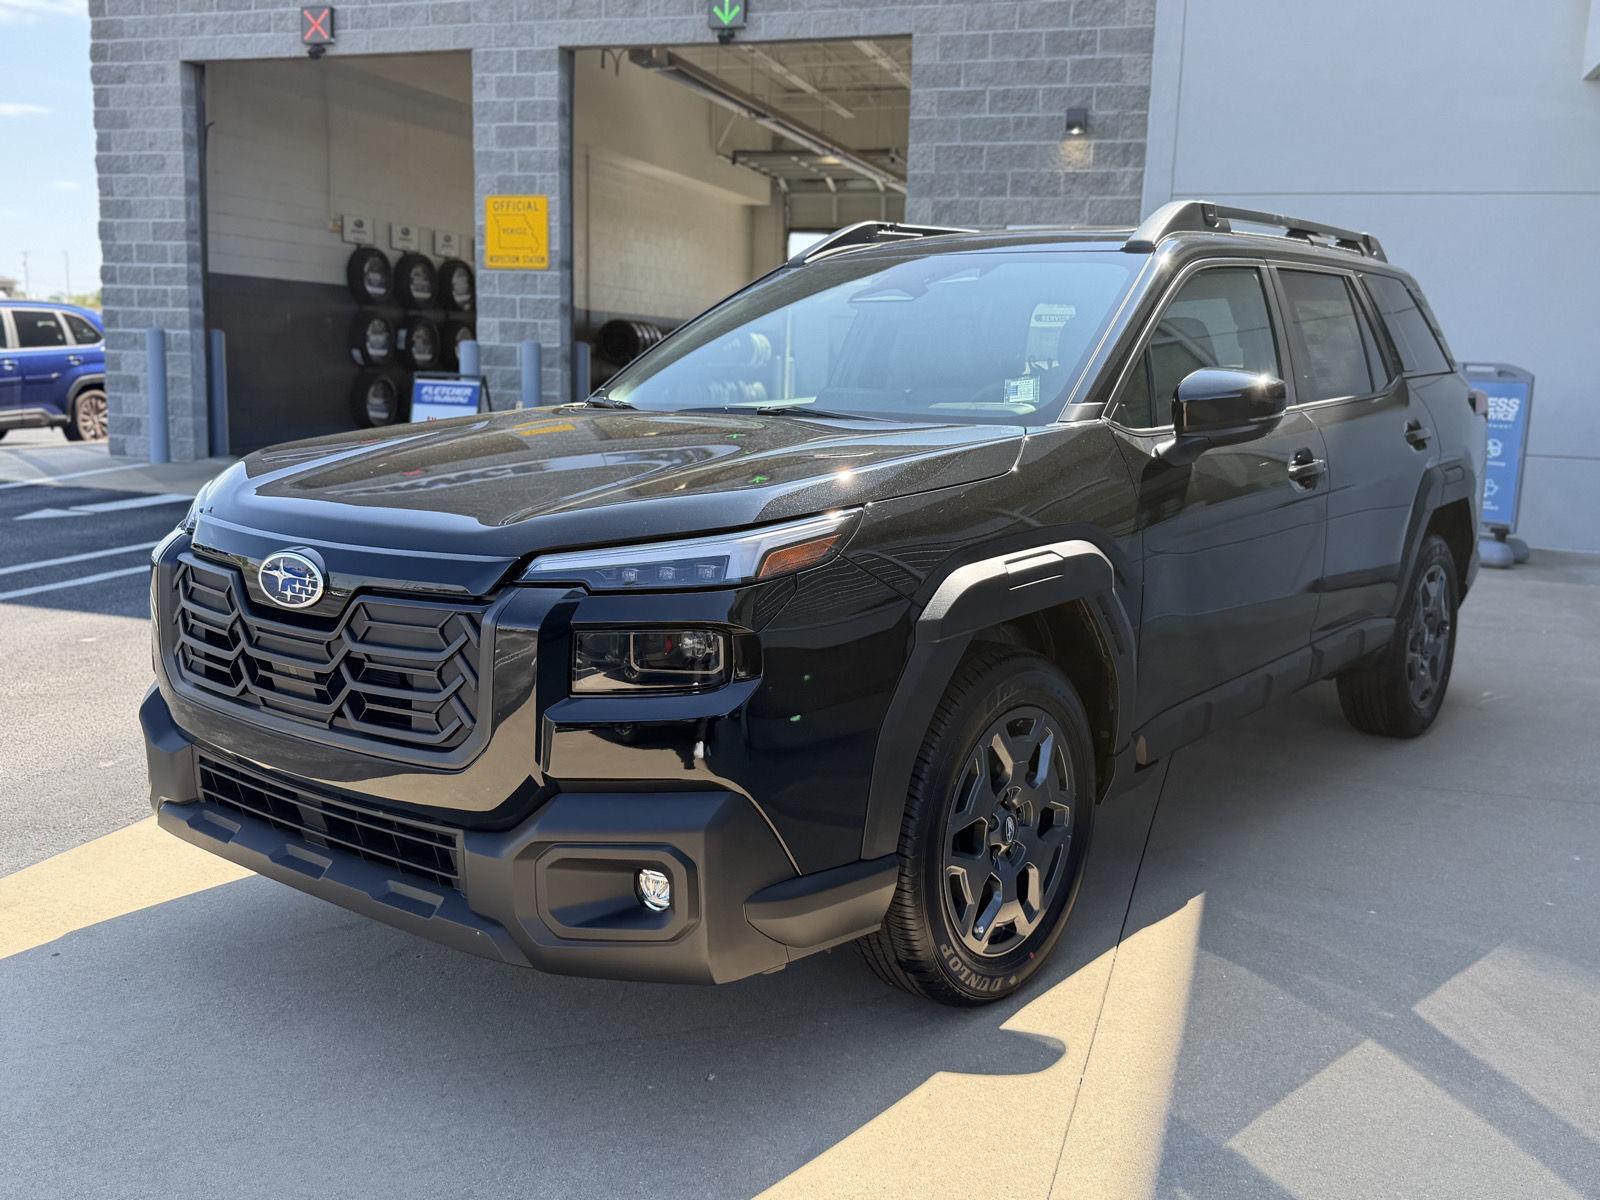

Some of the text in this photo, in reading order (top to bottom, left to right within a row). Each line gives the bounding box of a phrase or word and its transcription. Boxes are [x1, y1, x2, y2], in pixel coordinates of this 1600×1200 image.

[492, 201, 539, 212] OFFICIAL
[421, 385, 473, 397] FLETCHER
[940, 943, 1005, 992] DUNLOP
